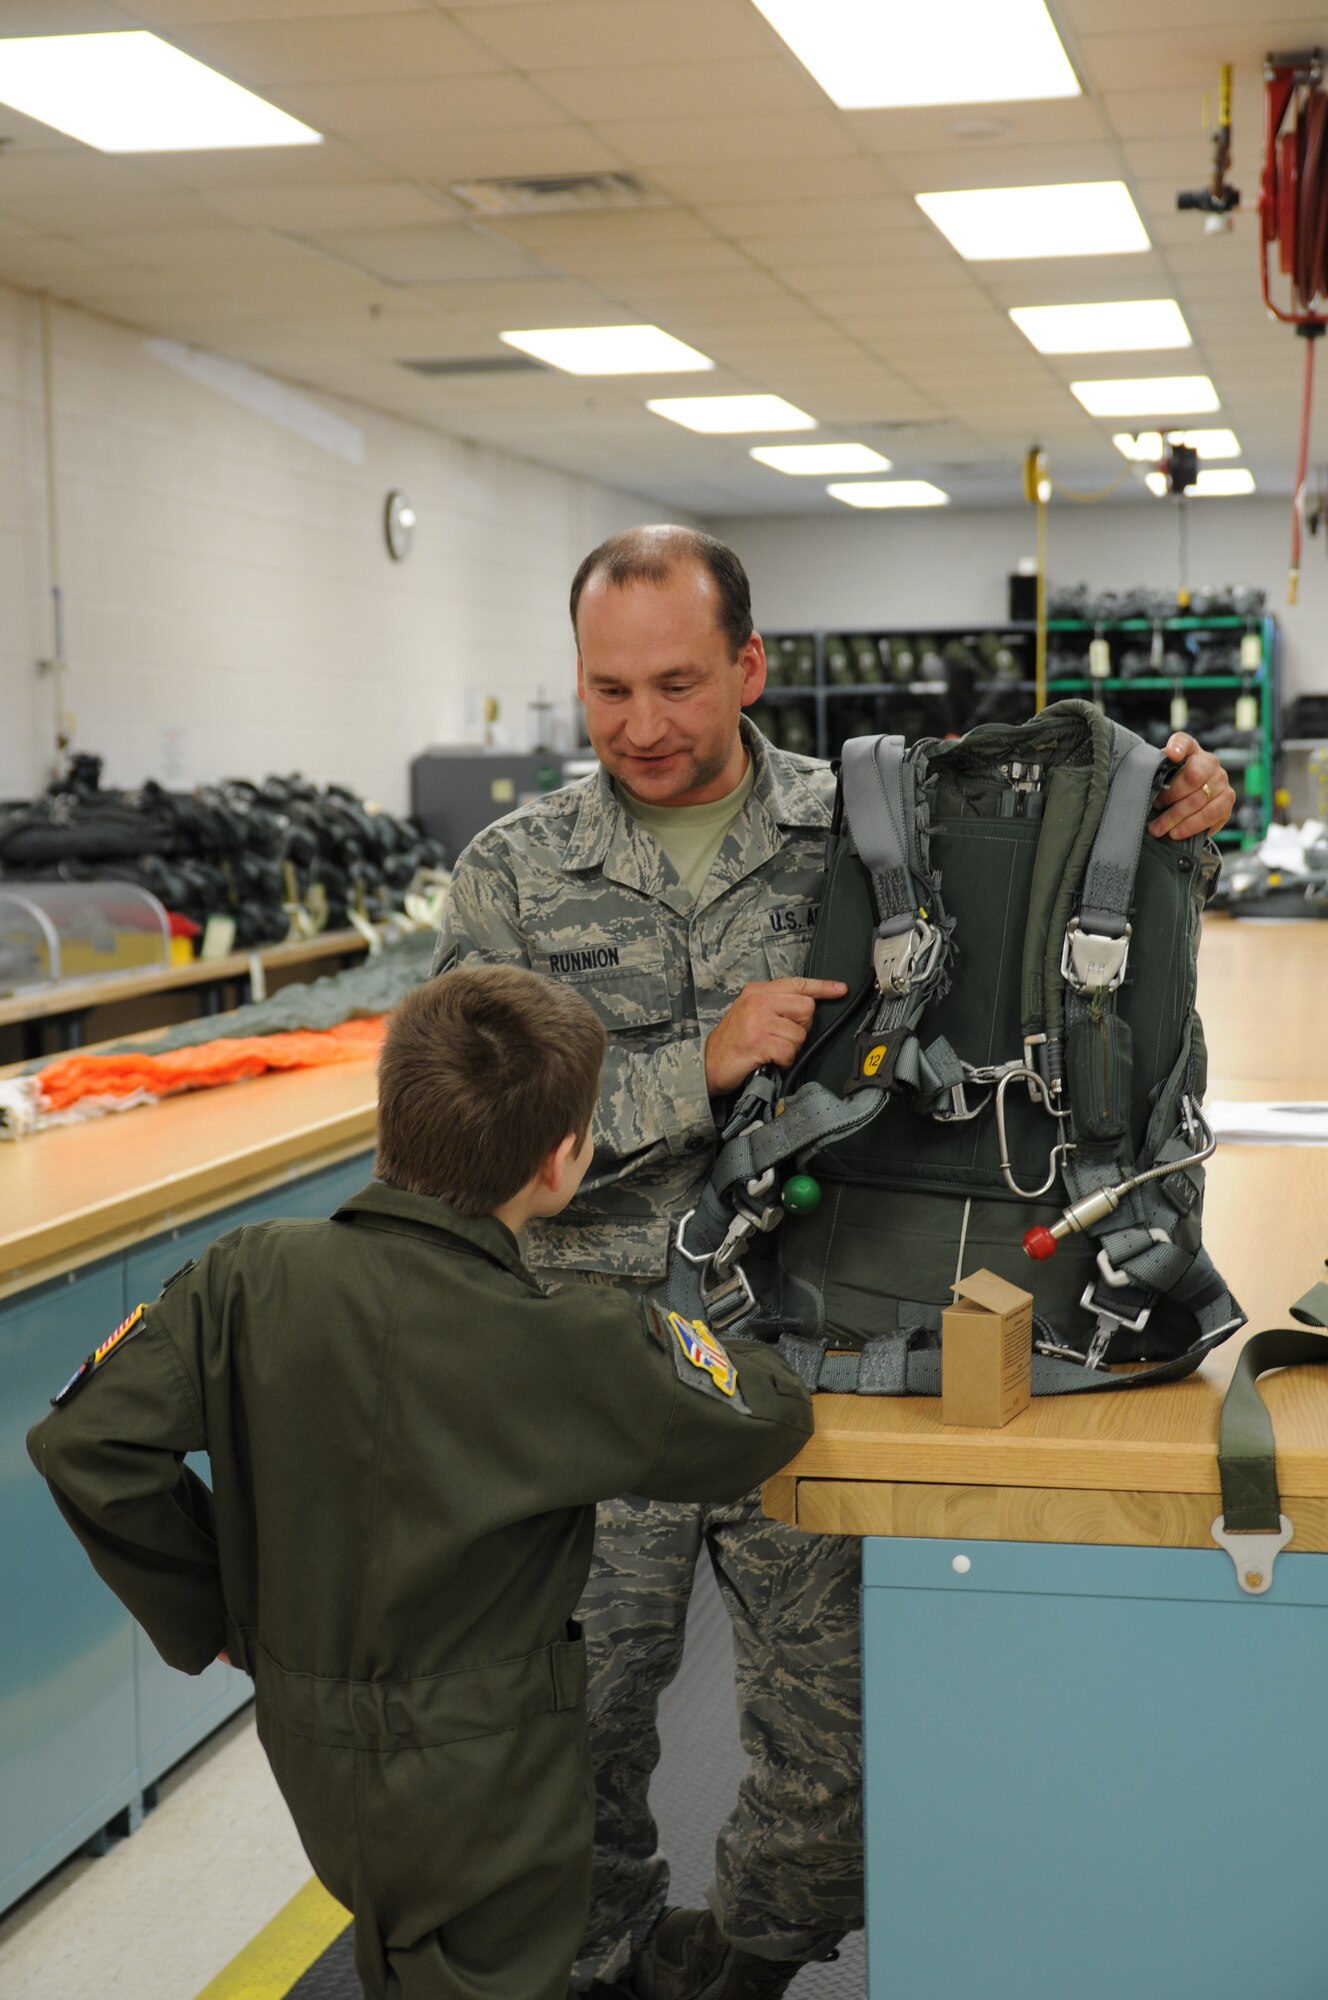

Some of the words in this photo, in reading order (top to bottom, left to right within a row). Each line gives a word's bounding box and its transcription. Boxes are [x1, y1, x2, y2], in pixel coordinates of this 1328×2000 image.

[769, 911, 802, 932] U.S.
[549, 947, 619, 972] RUNNION
[868, 1054, 881, 1067] 12
